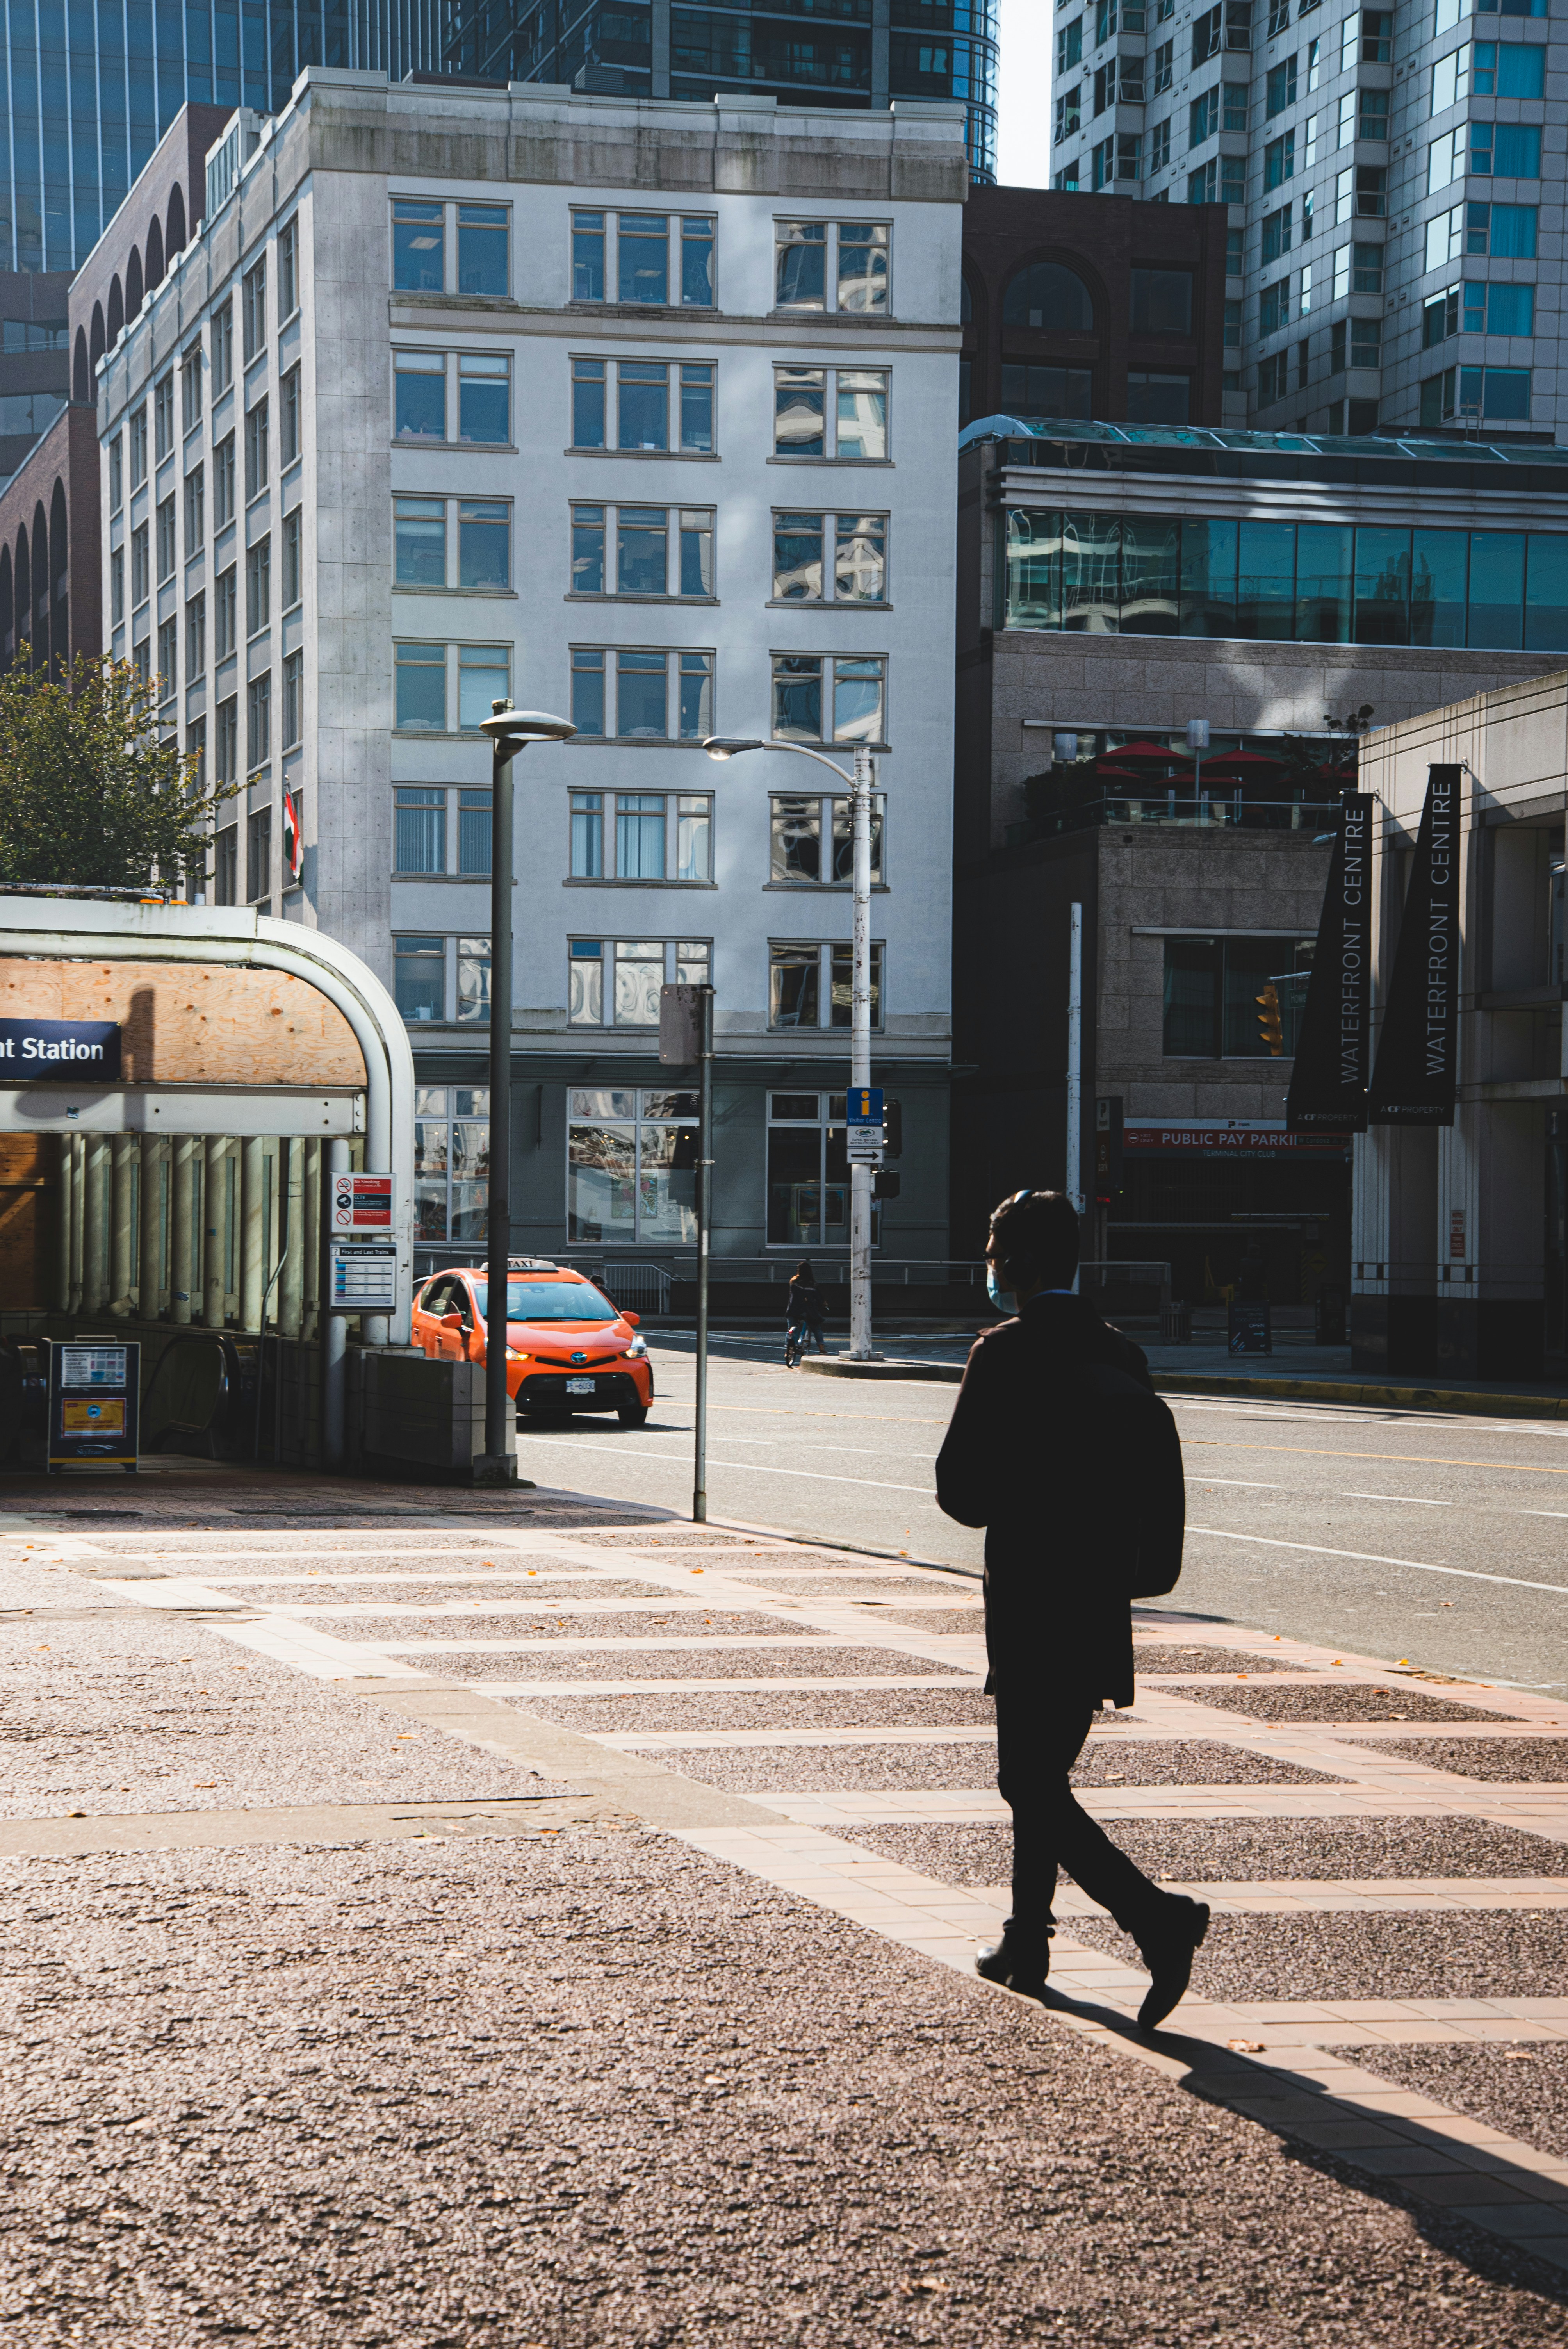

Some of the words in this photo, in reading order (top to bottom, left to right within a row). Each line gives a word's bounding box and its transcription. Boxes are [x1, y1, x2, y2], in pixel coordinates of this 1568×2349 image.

[1343, 809, 1364, 905] CENTRE
[1431, 783, 1450, 885] CENTRE
[1341, 918, 1361, 1084] WATERFRONT
[1426, 898, 1449, 1075] WATERFRONT
[22, 1037, 103, 1060] Station
[1162, 1133, 1213, 1144] PUBLIC
[1219, 1134, 1246, 1145] PAY
[1251, 1134, 1297, 1146] PARKI
